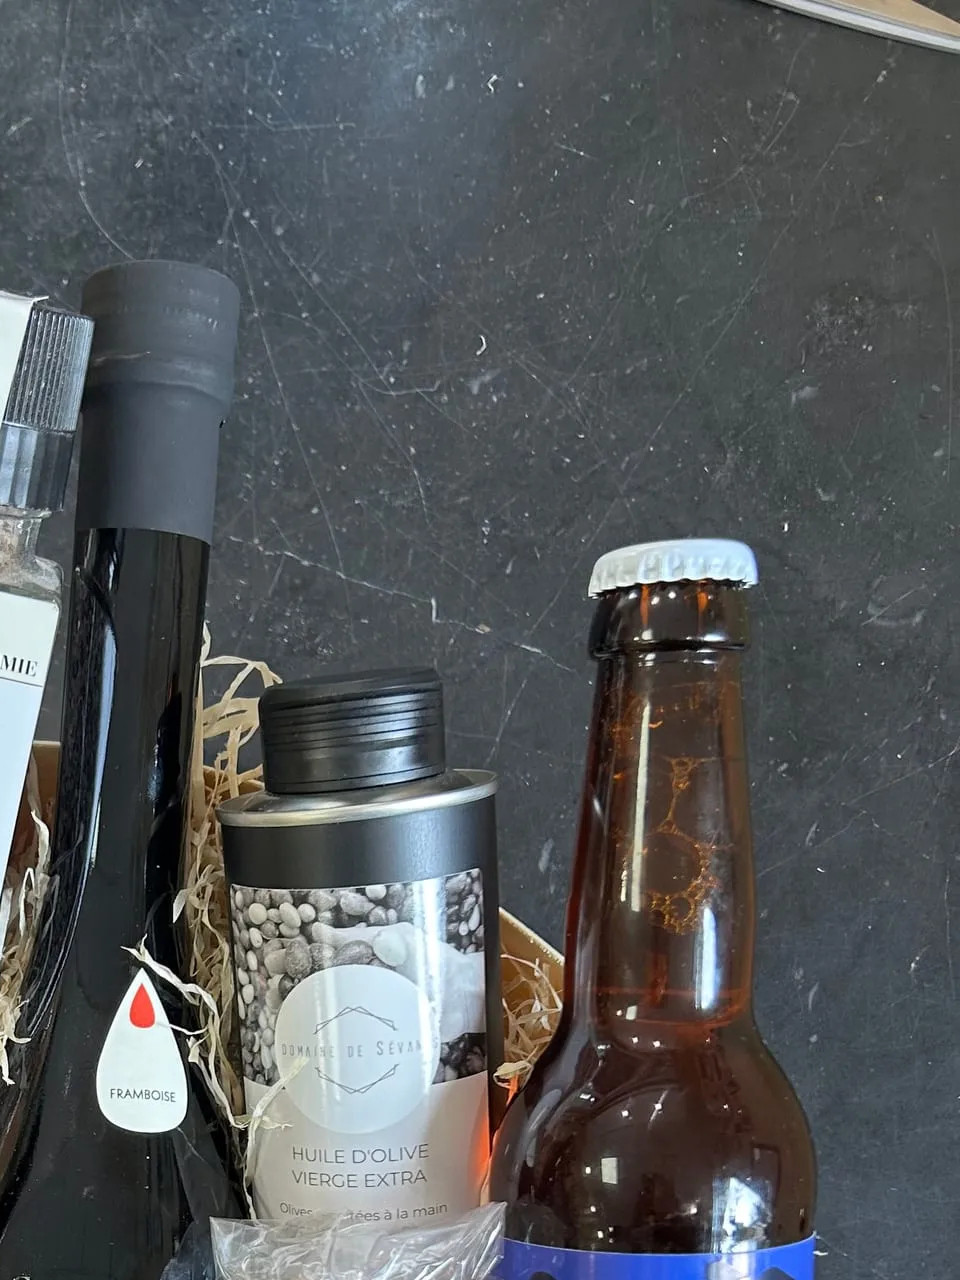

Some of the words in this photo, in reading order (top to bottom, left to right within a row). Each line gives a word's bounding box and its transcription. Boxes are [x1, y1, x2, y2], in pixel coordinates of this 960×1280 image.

[282, 1043, 335, 1058] DOMAINE
[348, 1044, 364, 1058] DE
[110, 1088, 176, 1103] FRAMBOISE
[292, 1146, 345, 1164] HUILE
[352, 1143, 430, 1165] D'OLIVE
[291, 1169, 358, 1189] VIERGE
[364, 1169, 427, 1188] EXTRA
[396, 1208, 408, 1220] la
[413, 1203, 448, 1218] main
